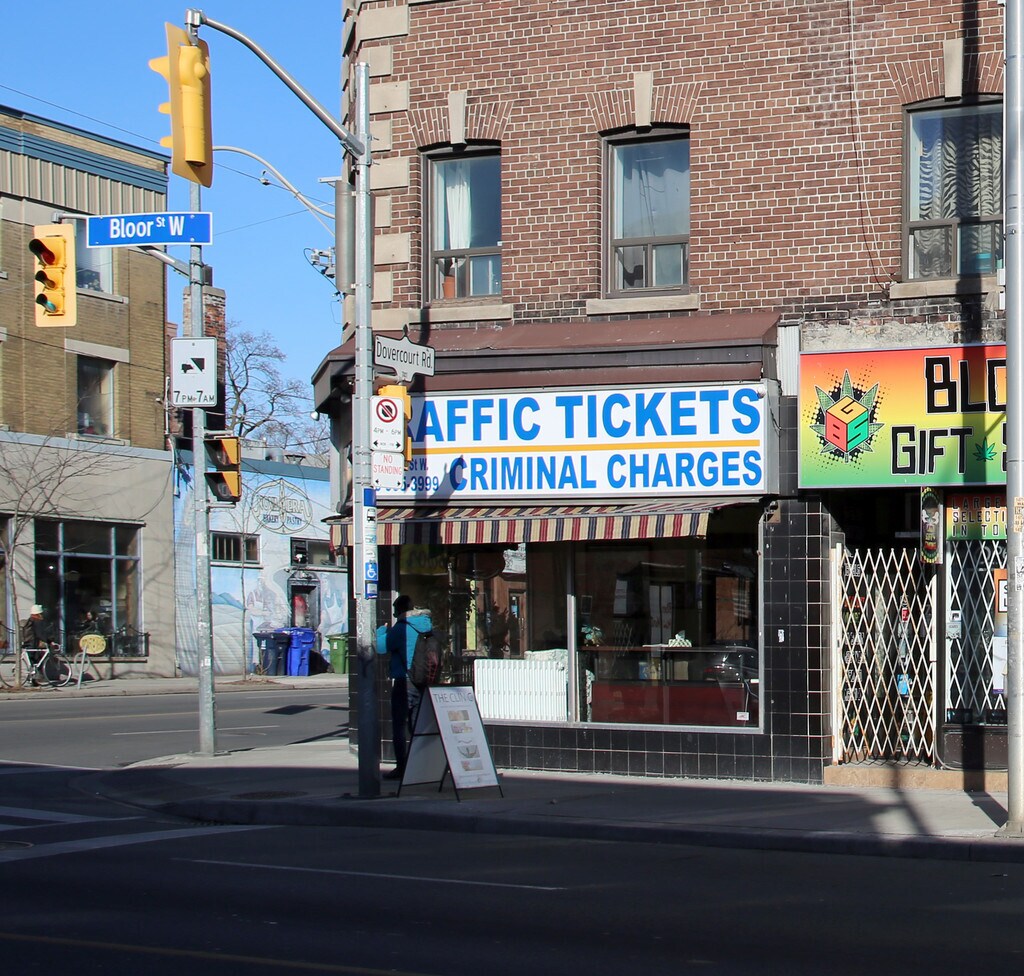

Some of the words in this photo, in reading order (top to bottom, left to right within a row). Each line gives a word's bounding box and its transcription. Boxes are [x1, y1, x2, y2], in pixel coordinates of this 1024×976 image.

[109, 218, 154, 239] Bloor
[156, 216, 166, 228] St
[169, 216, 185, 236] W
[376, 341, 420, 367] Dovercourt
[421, 351, 433, 369] Rd.
[556, 388, 762, 440] TICKETS
[891, 424, 974, 475] GIFT
[383, 454, 393, 464] NO
[373, 465, 402, 475] STANDING
[450, 454, 597, 492] CRIMINAL
[607, 449, 763, 489] CHARGES
[952, 497, 1001, 509] LARGE
[952, 524, 968, 537] IN
[433, 693, 449, 703] THE
